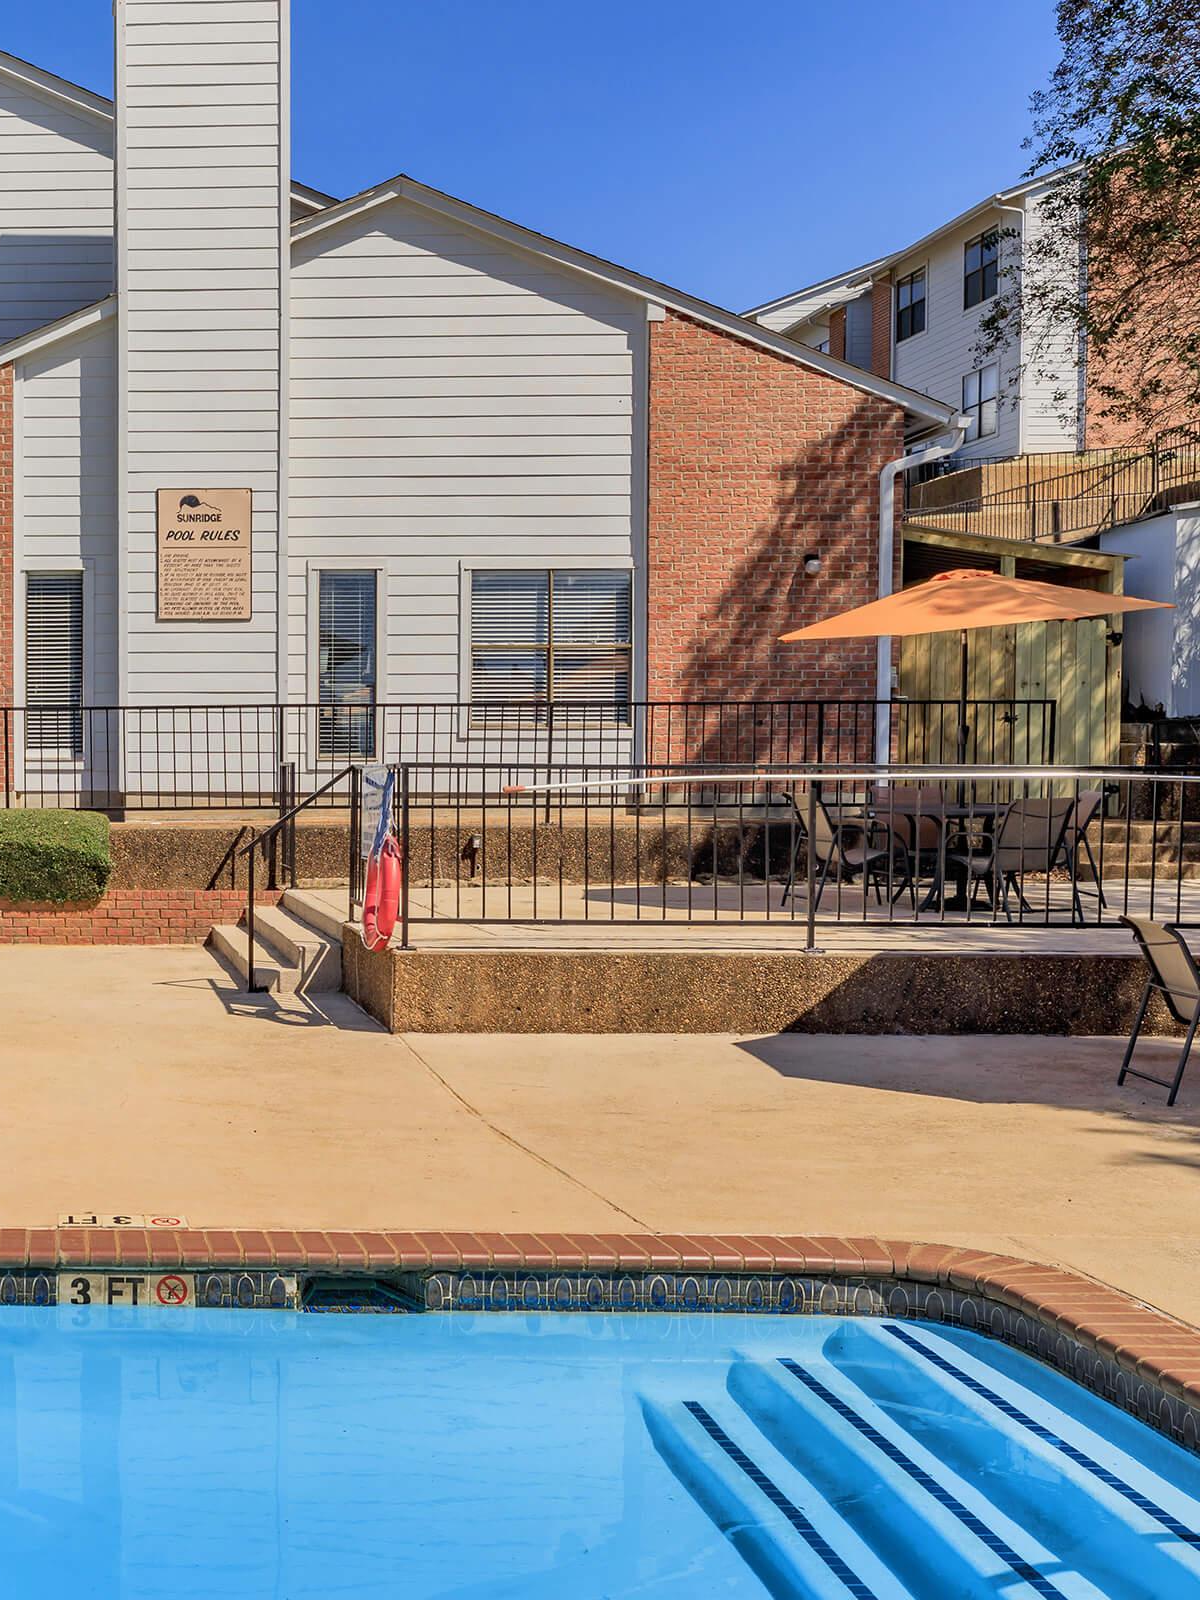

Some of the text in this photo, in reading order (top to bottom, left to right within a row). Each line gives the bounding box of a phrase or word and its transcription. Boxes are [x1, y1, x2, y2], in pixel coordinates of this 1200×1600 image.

[176, 513, 223, 523] SUNRIDGE
[165, 529, 241, 542] POOL RULES
[70, 1276, 145, 1306] 3 FT
